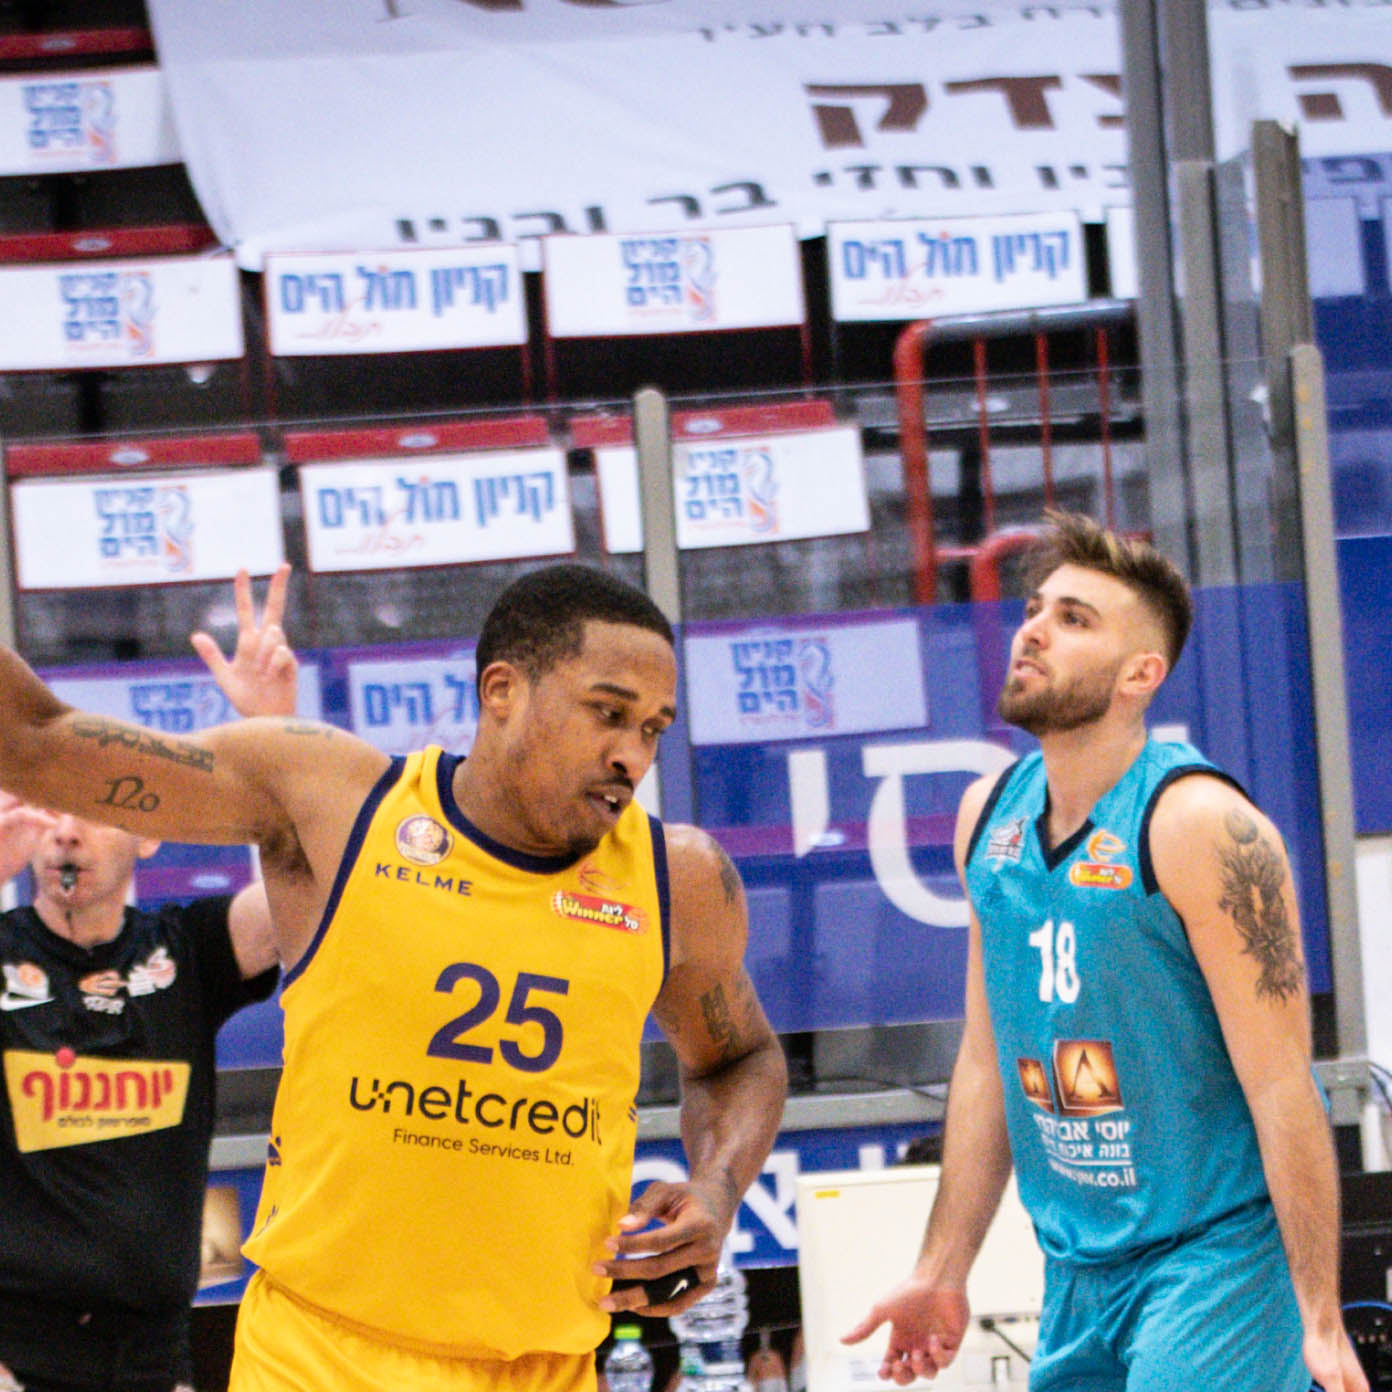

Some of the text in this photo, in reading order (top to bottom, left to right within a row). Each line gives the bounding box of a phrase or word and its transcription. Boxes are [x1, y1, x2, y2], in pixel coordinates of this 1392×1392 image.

[647, 177, 779, 217] בר
[375, 862, 474, 898] KELME
[563, 897, 623, 925] Winner
[1029, 918, 1081, 1003] 18
[425, 960, 570, 1075] 25
[20, 1067, 175, 1123] יוחננוף
[348, 1075, 604, 1149] unetcredit
[392, 1127, 576, 1168] Finance Services Ltd.
